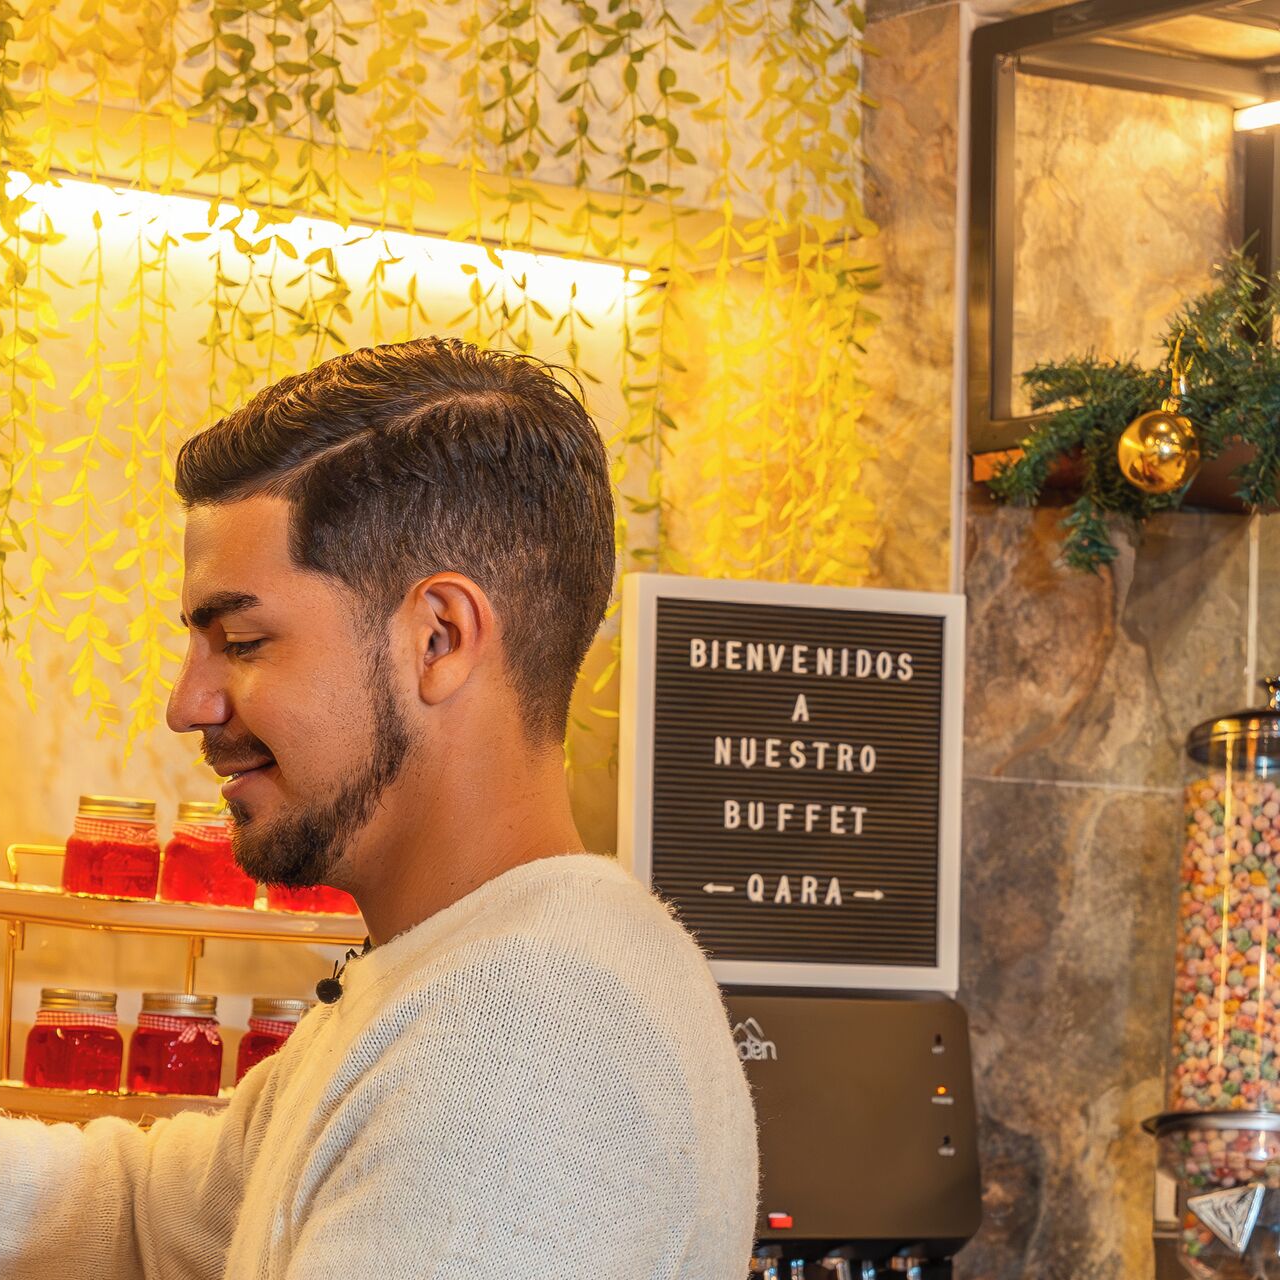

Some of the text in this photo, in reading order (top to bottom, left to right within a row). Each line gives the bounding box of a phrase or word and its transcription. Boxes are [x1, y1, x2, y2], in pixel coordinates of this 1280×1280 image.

[690, 638, 914, 681] BIENVENIDOS
[791, 693, 810, 723] A
[714, 736, 877, 773] NUESTRO
[724, 799, 868, 835] BUFFET
[746, 873, 842, 906] QARA
